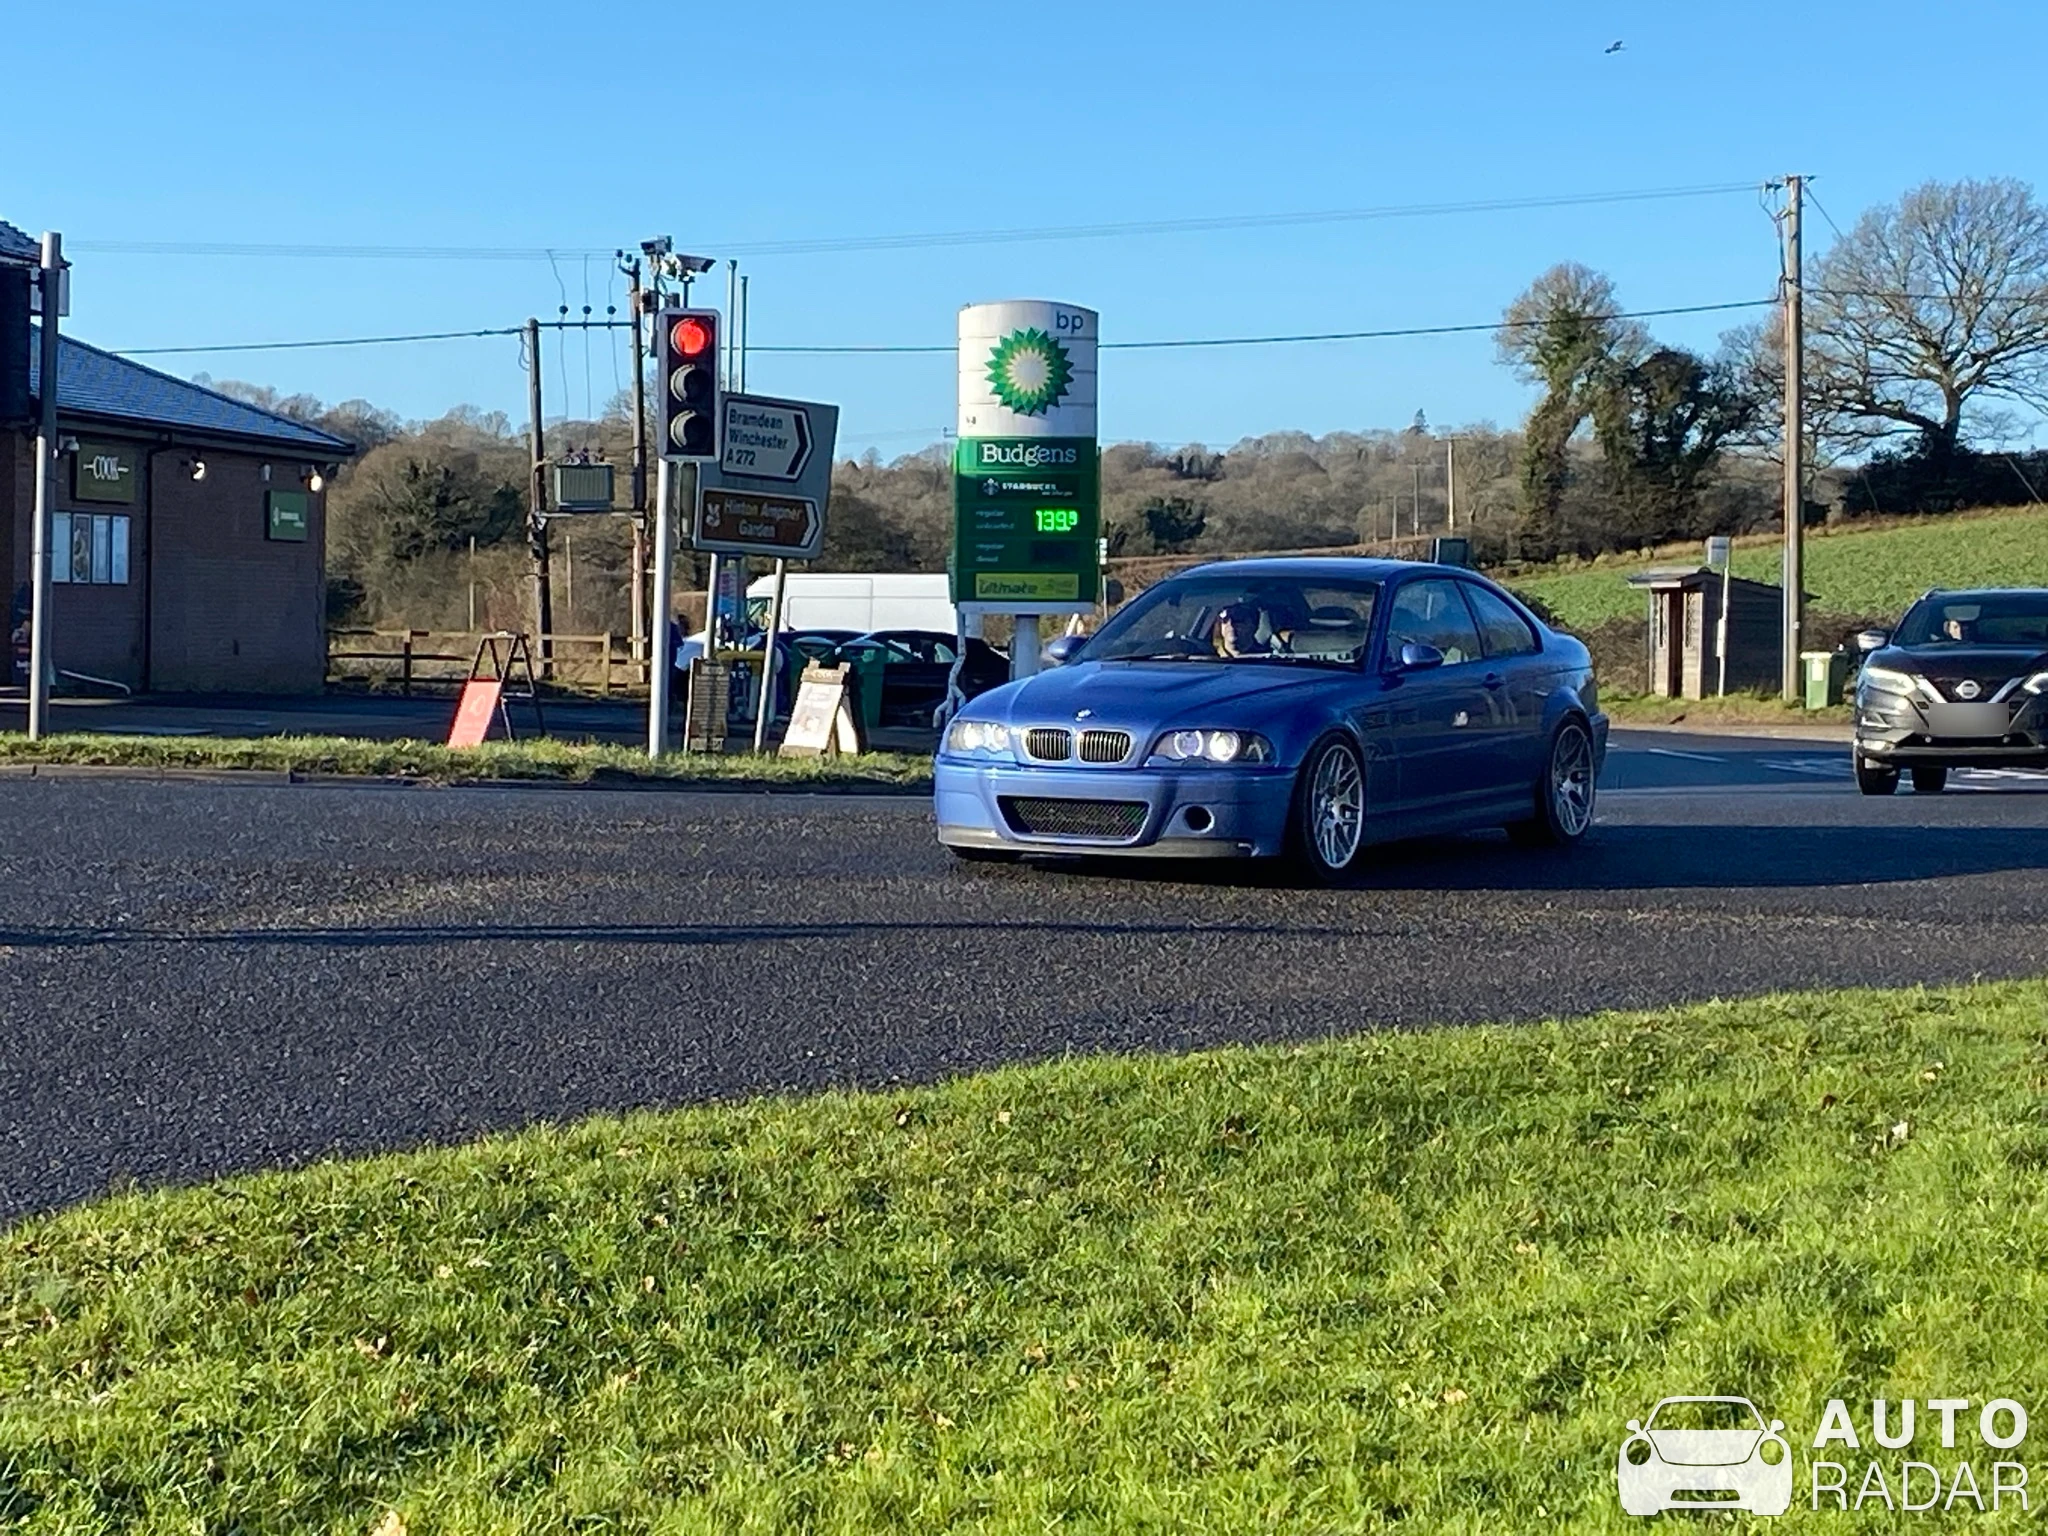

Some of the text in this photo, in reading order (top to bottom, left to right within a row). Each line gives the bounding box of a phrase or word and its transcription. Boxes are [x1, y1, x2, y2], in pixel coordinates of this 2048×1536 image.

[1057, 311, 1083, 334] bp
[729, 408, 783, 429] Bramdean
[729, 428, 788, 450] Winchester
[982, 443, 1077, 467] Budgens
